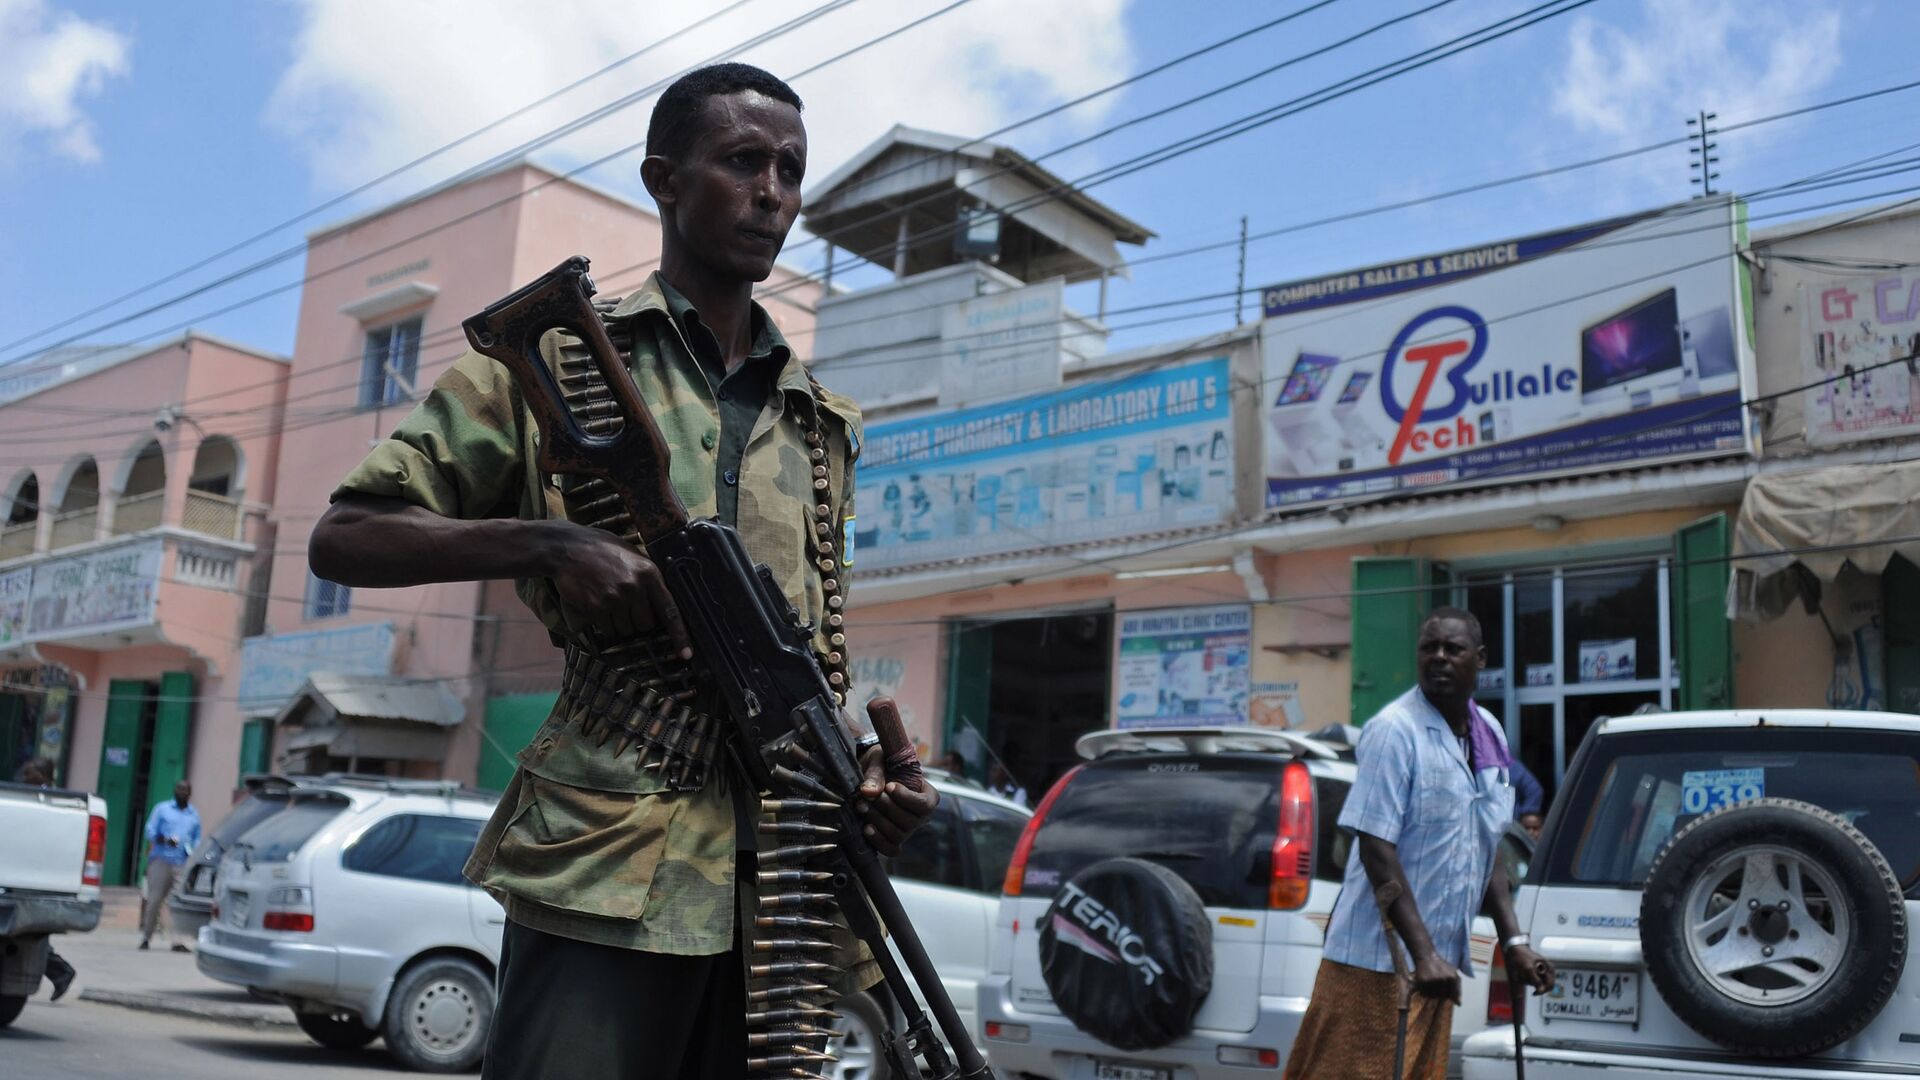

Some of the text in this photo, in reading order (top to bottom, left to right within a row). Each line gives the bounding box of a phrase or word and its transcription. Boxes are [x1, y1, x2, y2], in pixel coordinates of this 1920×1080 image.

[1265, 243, 1520, 309] COMPUTER SALES & SERVICE
[933, 412, 1025, 458] PHARMACY
[1028, 410, 1043, 440] &
[1046, 385, 1161, 435] LABORATORY
[1165, 378, 1199, 415] KM
[1204, 375, 1217, 411] 5
[1387, 339, 1477, 466] Tech
[1544, 1002, 1593, 1017] SOMALIA
[1572, 972, 1623, 1000] 9464
